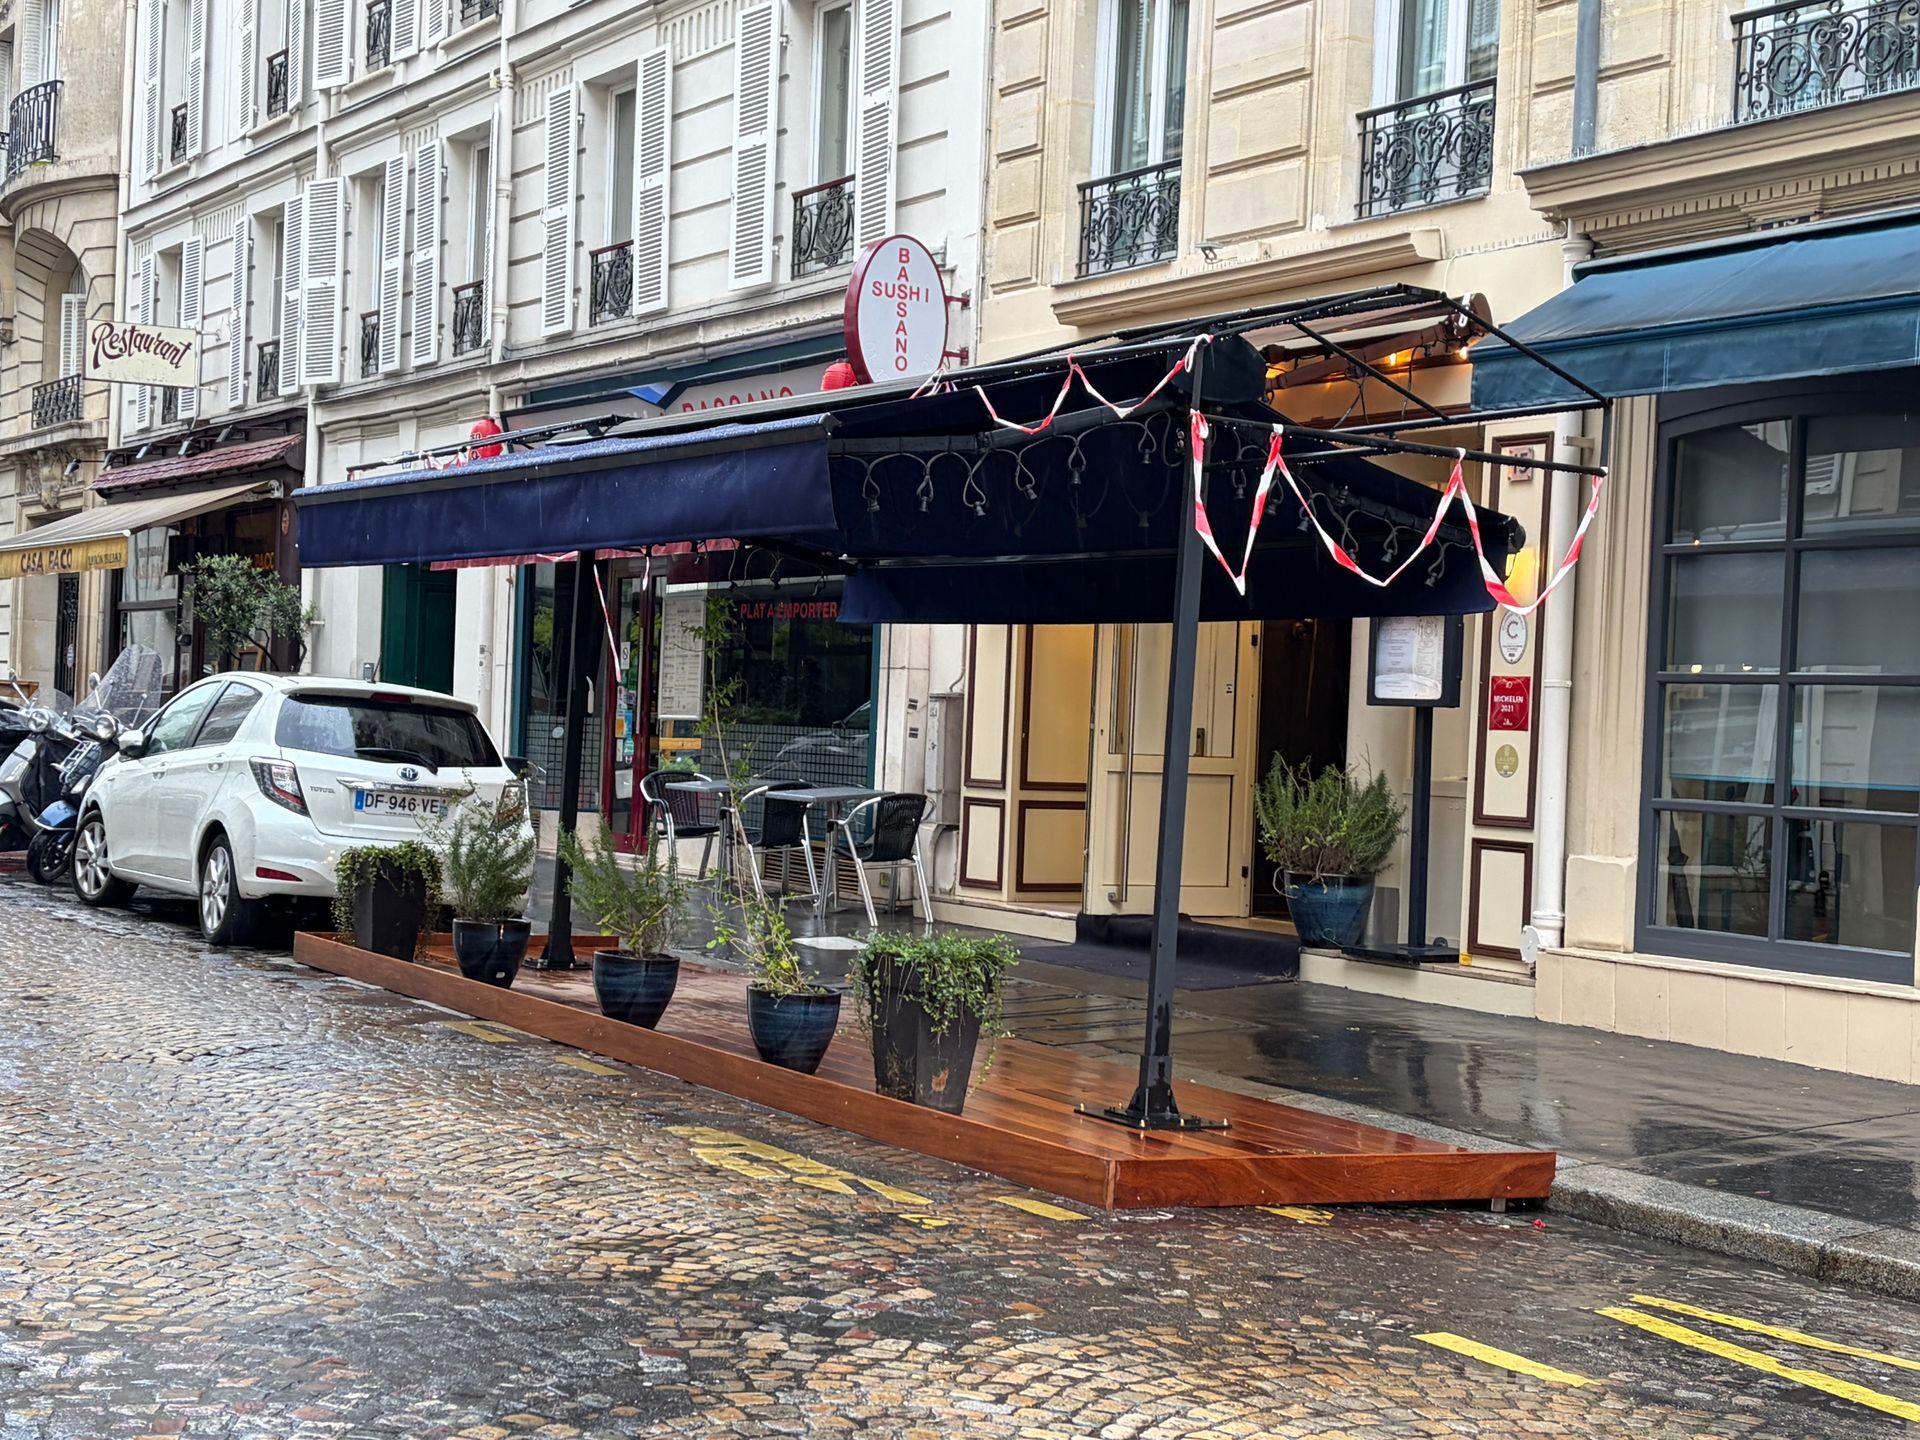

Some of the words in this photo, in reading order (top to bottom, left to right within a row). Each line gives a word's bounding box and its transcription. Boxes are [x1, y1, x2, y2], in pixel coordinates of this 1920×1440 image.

[871, 280, 929, 303] SUSHI
[895, 247, 910, 372] BASSANO
[92, 322, 193, 370] Restaurant
[20, 551, 44, 575] CASA
[48, 548, 73, 570] PACO
[740, 603, 766, 619] PLAT
[777, 602, 838, 619] EMPORTER
[1493, 695, 1524, 703] MICHELIN
[1500, 704, 1514, 712] 2021
[365, 792, 439, 814] DF-946-VE
